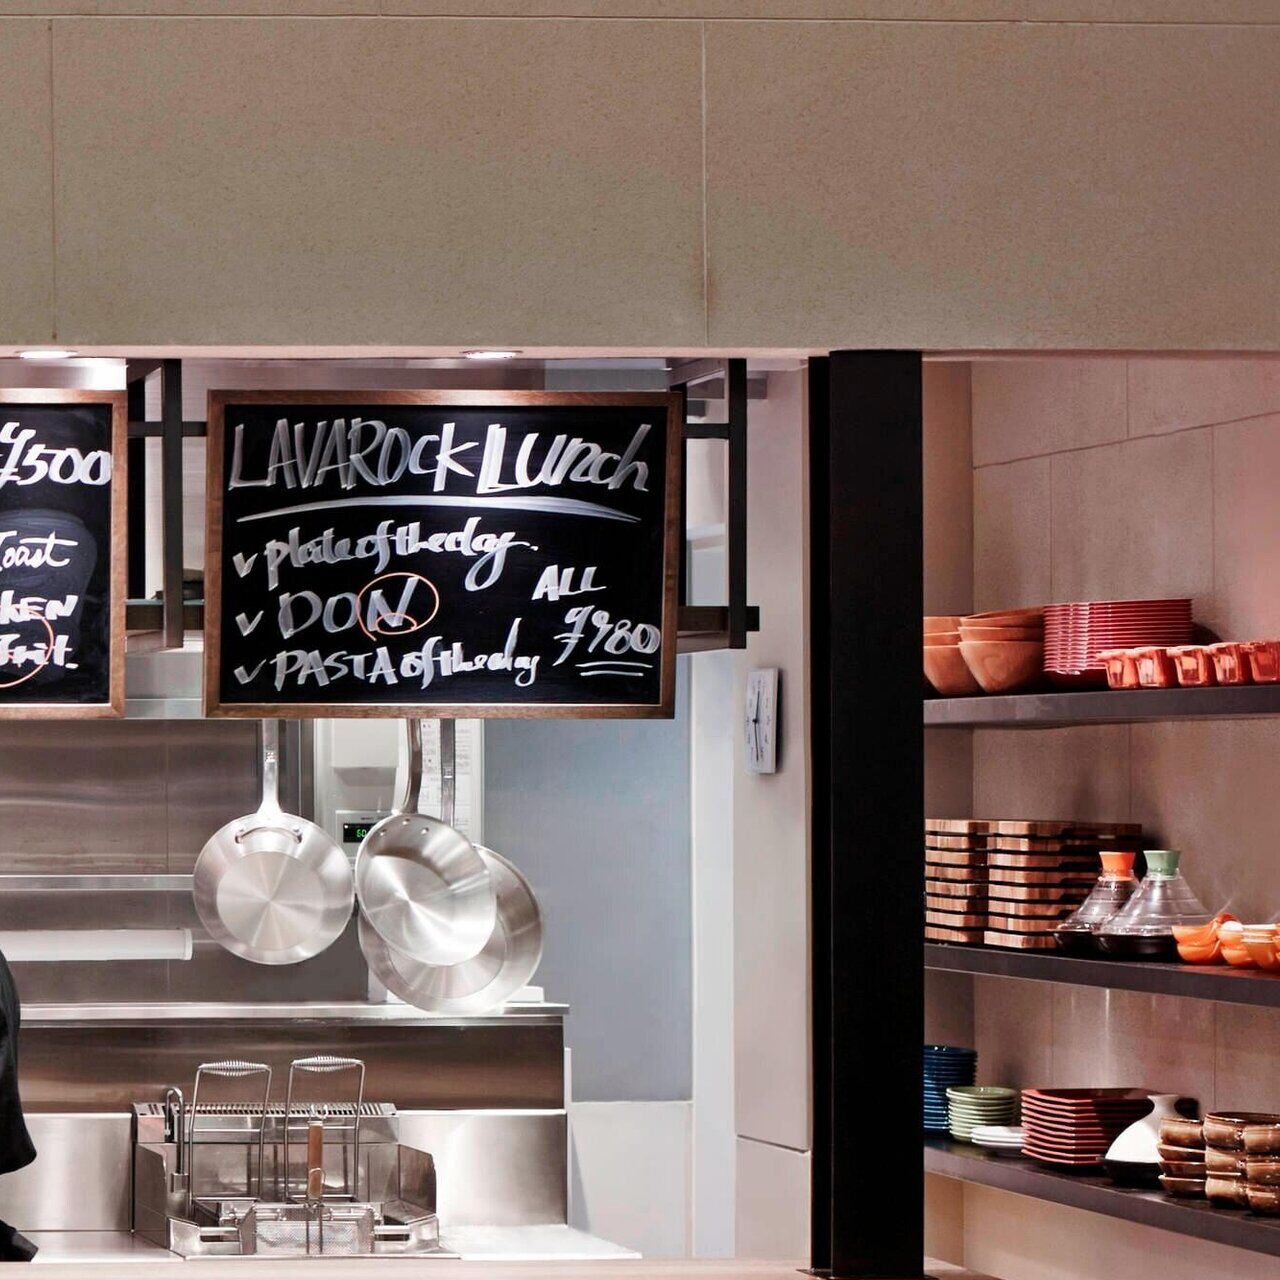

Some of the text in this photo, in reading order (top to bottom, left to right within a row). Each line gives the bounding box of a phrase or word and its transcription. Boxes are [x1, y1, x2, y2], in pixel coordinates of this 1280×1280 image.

[278, 576, 420, 639] DON
[531, 564, 608, 602] ALL
[552, 605, 662, 667] ¥980
[271, 646, 399, 692] PASTA
